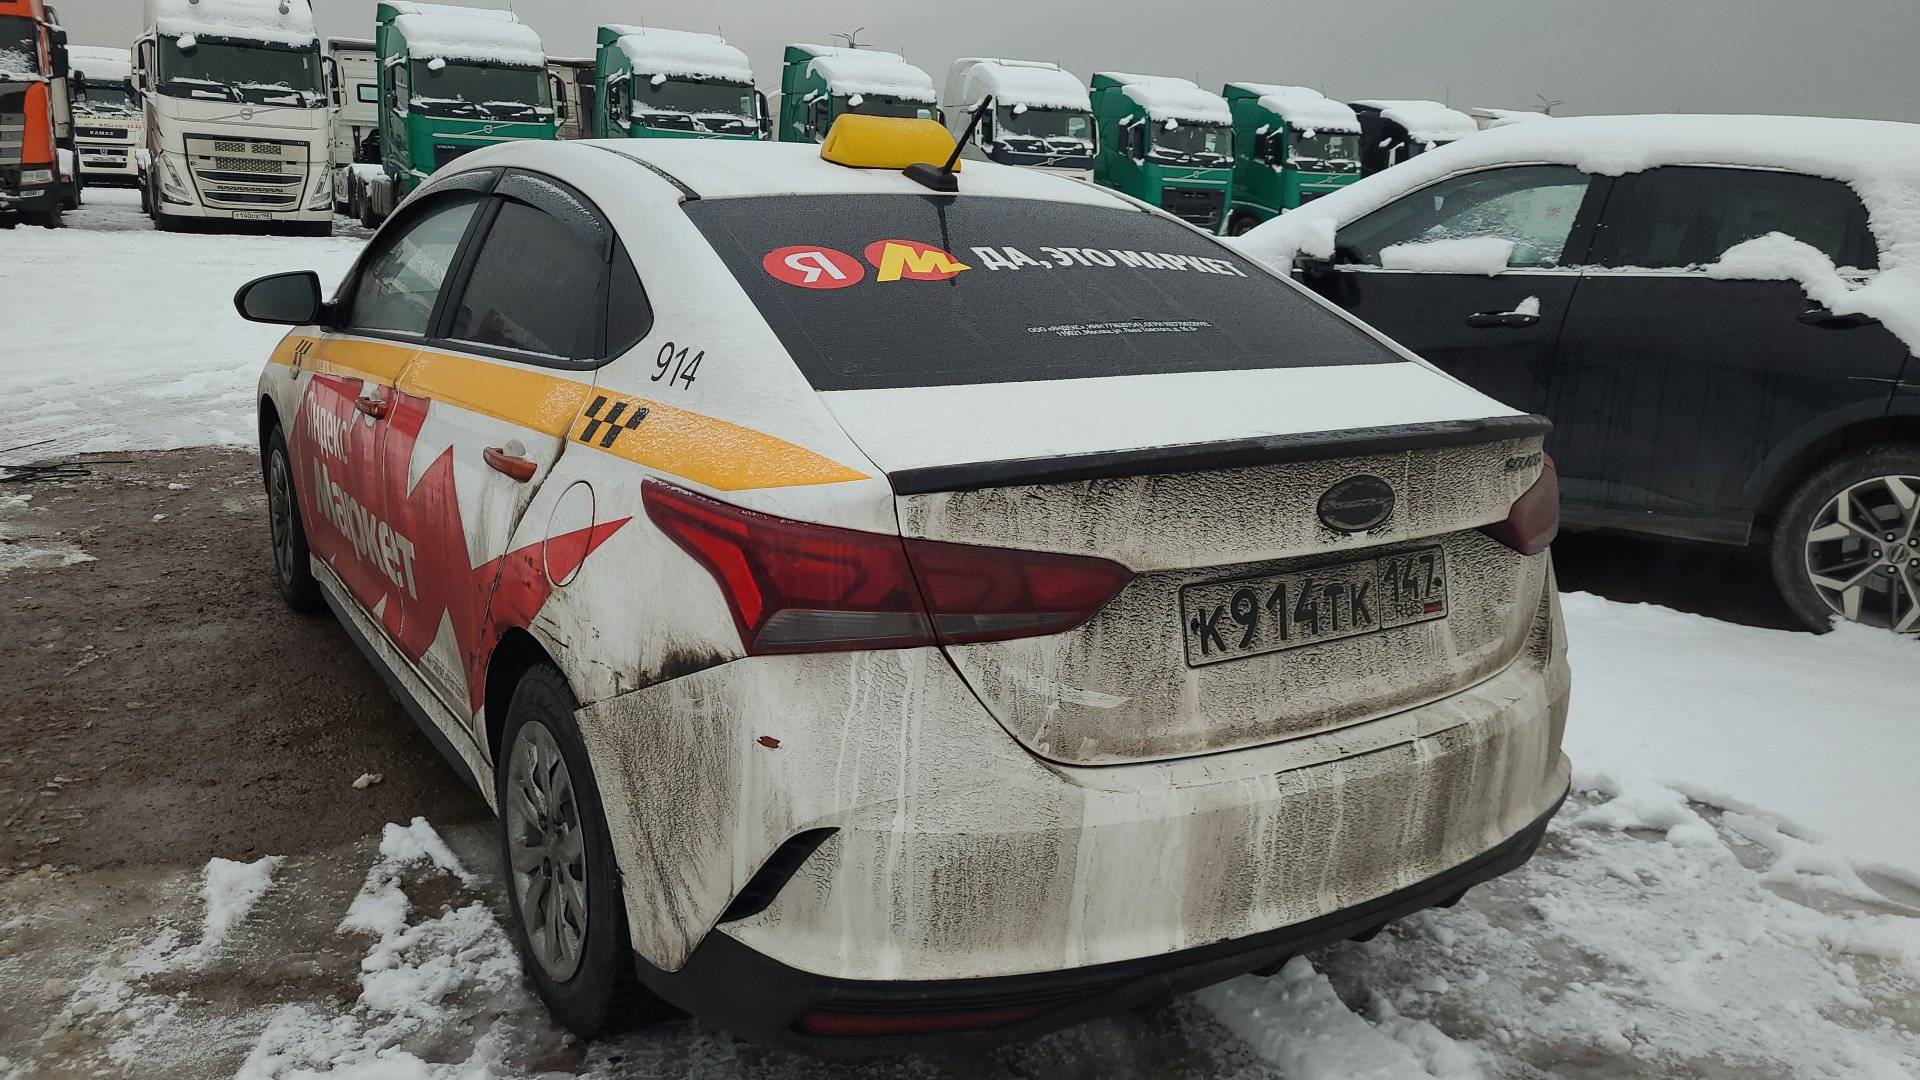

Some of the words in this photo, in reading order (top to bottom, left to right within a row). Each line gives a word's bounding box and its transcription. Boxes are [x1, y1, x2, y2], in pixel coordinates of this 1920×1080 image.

[784, 251, 847, 283] Я
[970, 246, 1053, 271] ДА,
[1039, 247, 1116, 267] ЭТО
[1107, 249, 1249, 278] МАРКЕТ
[651, 341, 705, 390] 914
[306, 390, 348, 465] Яндекс
[313, 456, 418, 601] Маркет
[1383, 554, 1434, 602] 147
